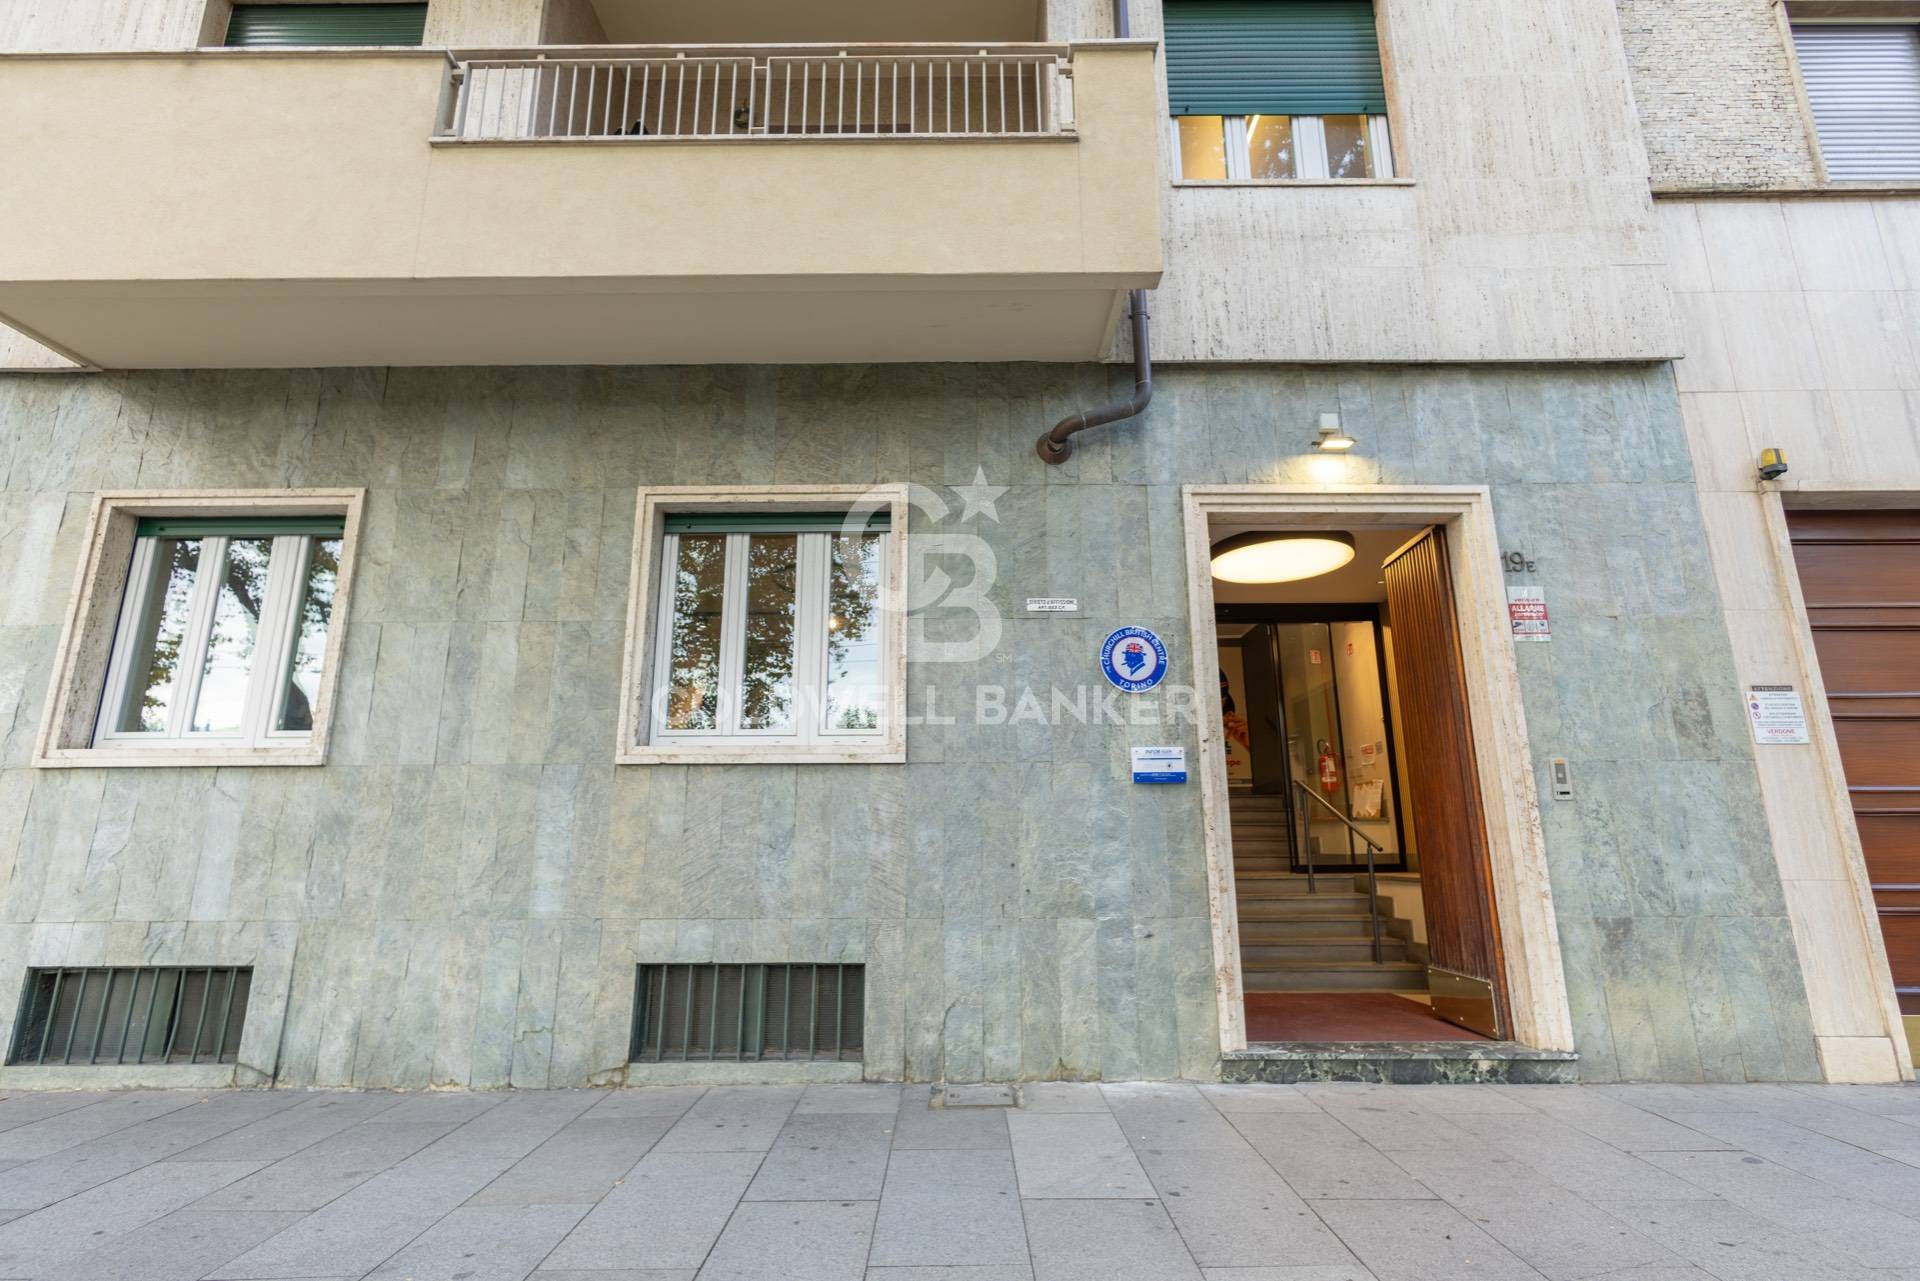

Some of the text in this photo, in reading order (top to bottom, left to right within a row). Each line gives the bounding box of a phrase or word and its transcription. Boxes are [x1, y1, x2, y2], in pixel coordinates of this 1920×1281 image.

[1103, 631, 1125, 665] CHURCHILL
[1125, 628, 1153, 641] BRITISH
[1151, 638, 1166, 665] CENTRE
[1118, 678, 1153, 690] TORINO
